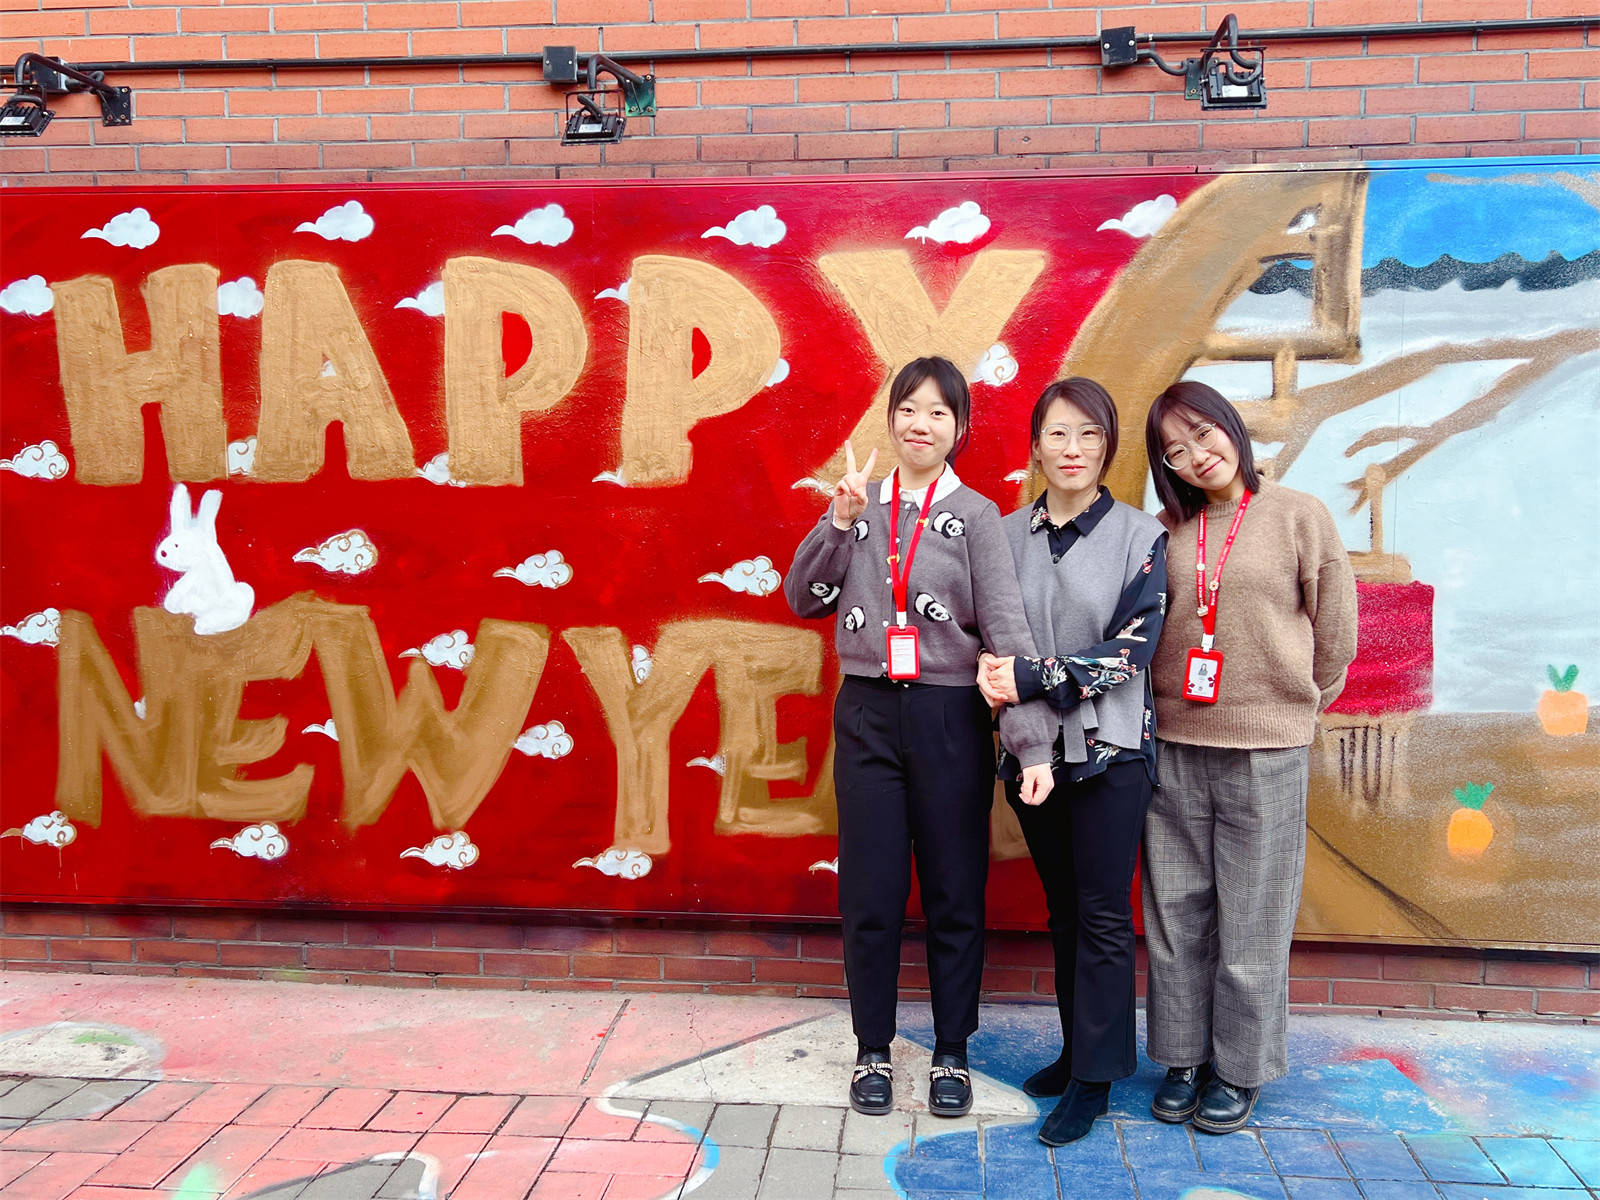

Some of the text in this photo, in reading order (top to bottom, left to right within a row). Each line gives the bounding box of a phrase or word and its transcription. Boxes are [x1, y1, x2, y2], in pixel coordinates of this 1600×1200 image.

[50, 249, 1048, 488] HAPPY
[55, 592, 1030, 860] NEW YE
